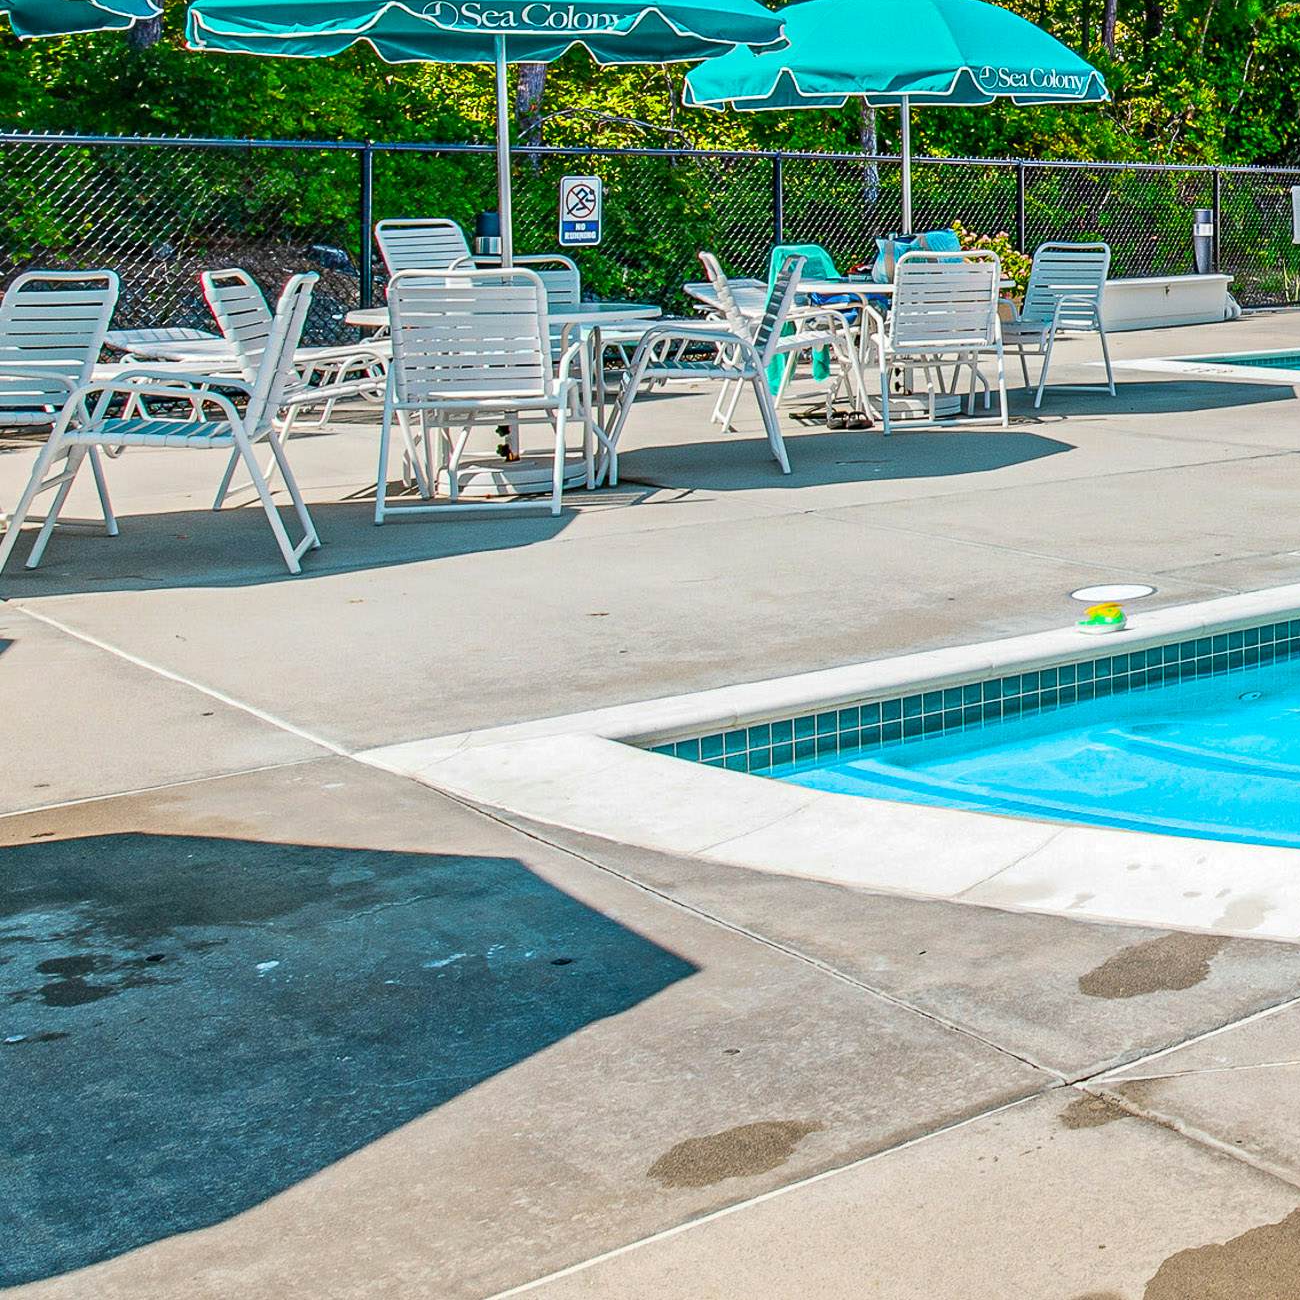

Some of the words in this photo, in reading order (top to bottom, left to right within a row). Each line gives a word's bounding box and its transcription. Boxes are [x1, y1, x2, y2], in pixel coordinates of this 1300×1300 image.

[460, 2, 519, 29] Sea
[521, 2, 634, 32] Colony
[998, 67, 1028, 88] Sea
[1030, 67, 1085, 95] Colony
[575, 222, 586, 231] NO
